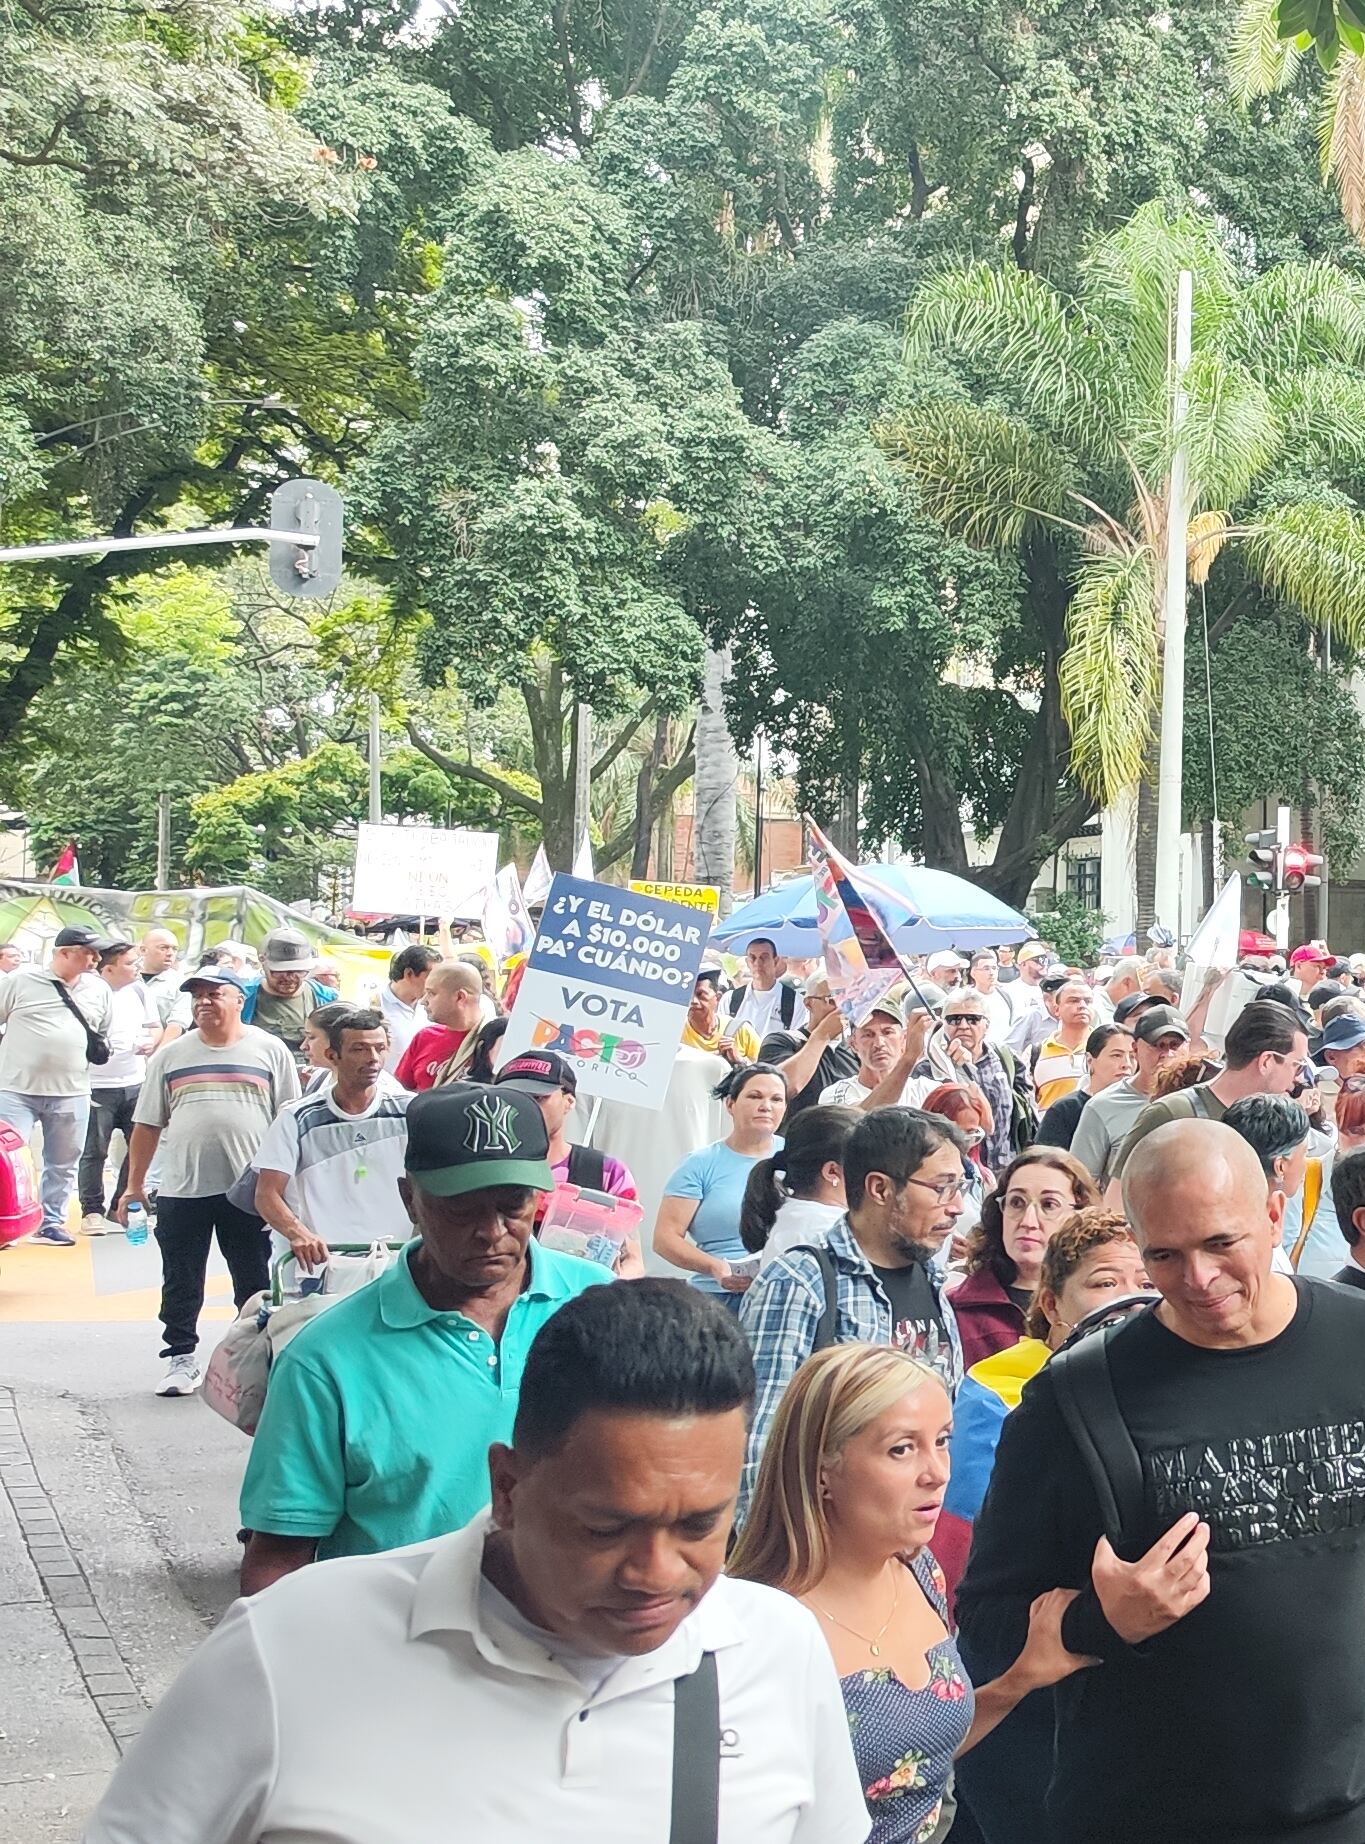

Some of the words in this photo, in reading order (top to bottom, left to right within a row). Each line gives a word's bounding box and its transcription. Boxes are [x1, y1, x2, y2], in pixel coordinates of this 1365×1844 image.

[643, 884, 703, 898] CEPEDA
[552, 894, 586, 915] ¿Y
[586, 902, 614, 923] EL
[619, 909, 701, 946] DÓLAR
[561, 919, 581, 938] A
[587, 922, 681, 962] $10.000
[577, 945, 695, 990] CUÁNDO?
[561, 986, 645, 1029] VOTA
